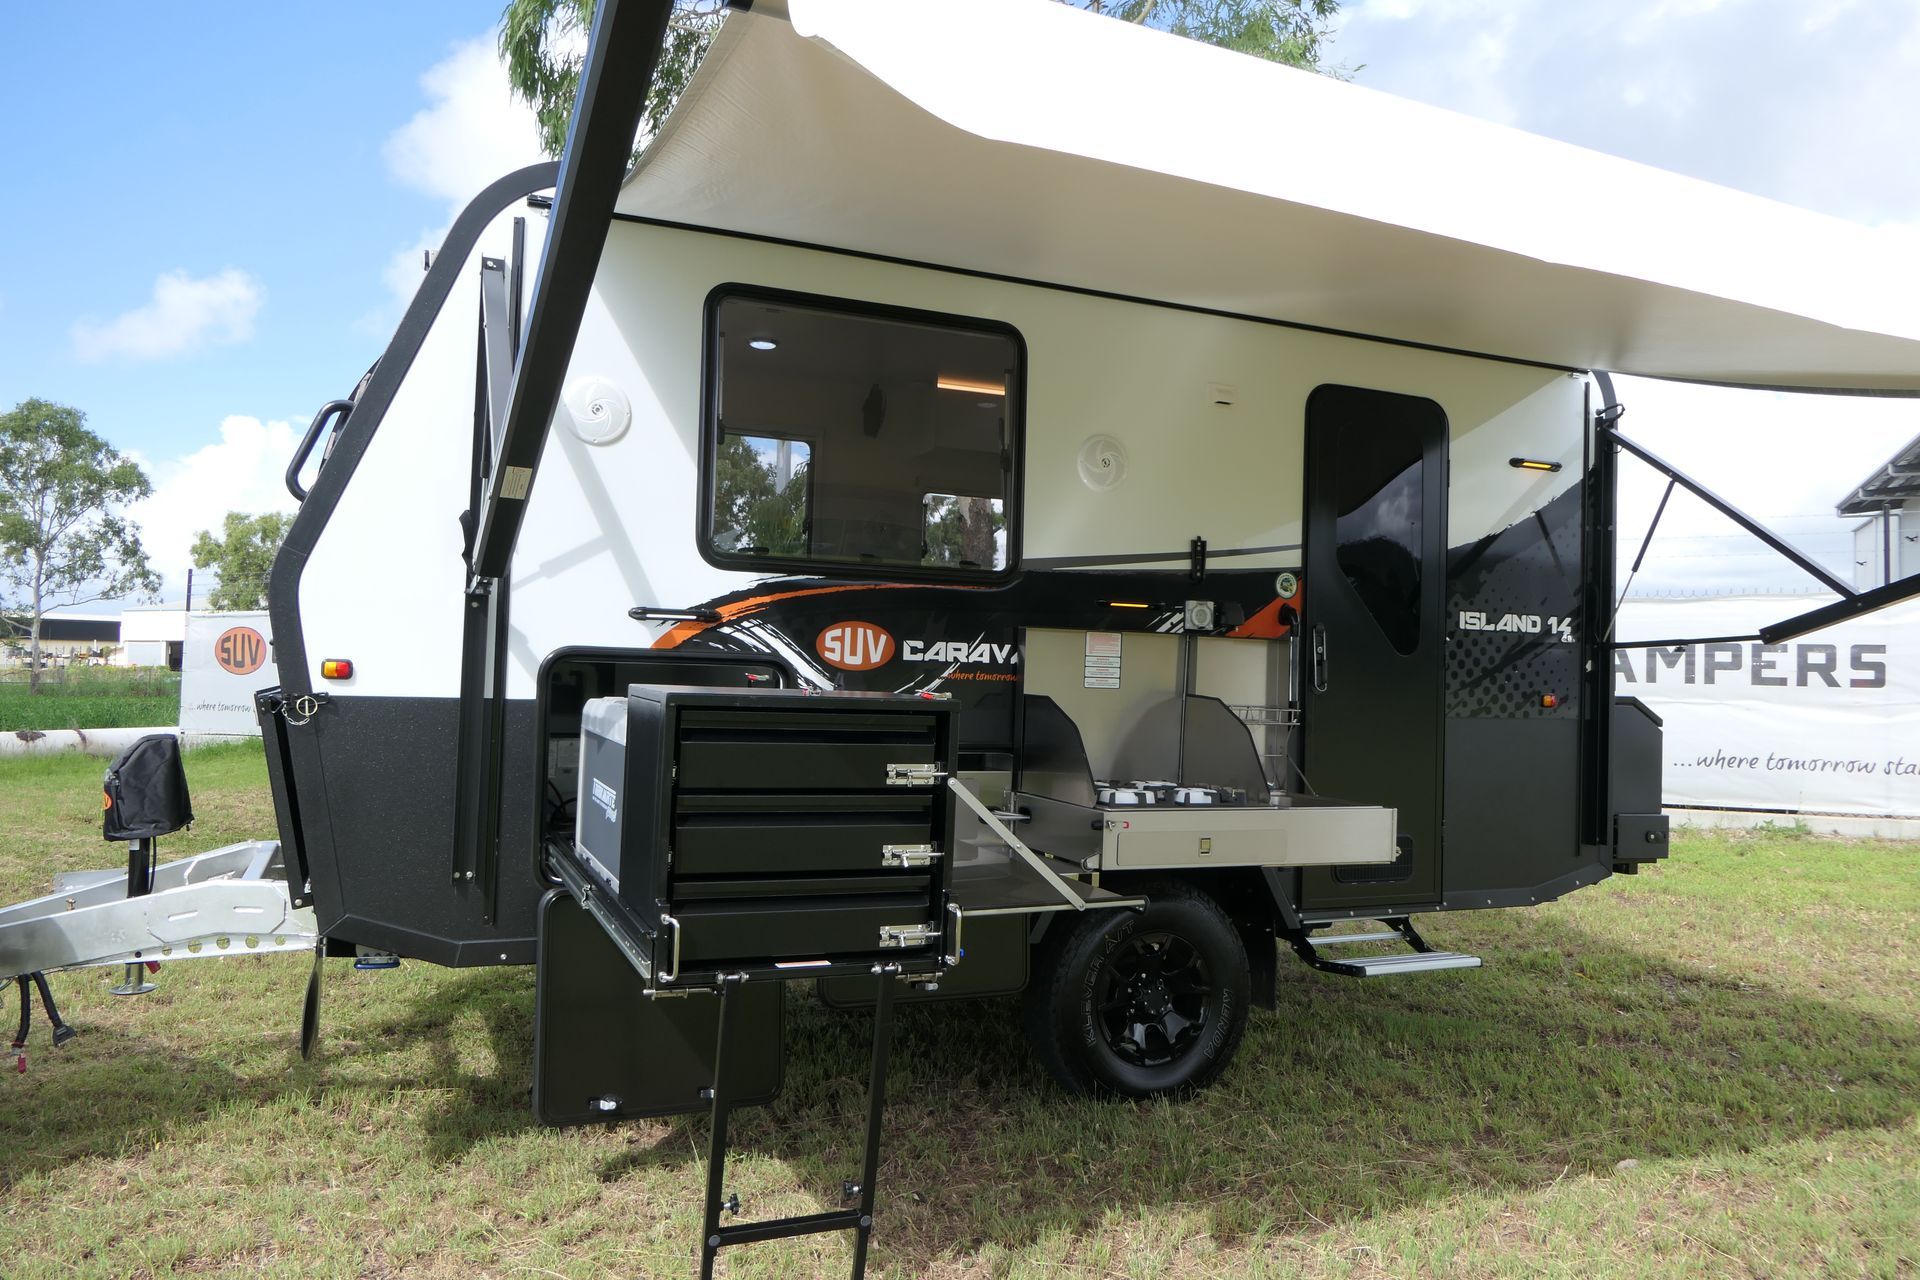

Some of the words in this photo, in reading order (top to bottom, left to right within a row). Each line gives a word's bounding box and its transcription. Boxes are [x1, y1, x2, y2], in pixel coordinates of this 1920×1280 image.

[1460, 611, 1541, 634] ISLAND
[220, 633, 261, 668] SUV
[824, 627, 887, 665] SUV
[217, 702, 251, 713] tomorrow
[1766, 752, 1877, 774] tomorrow
[1203, 987, 1233, 1060] KENDA
